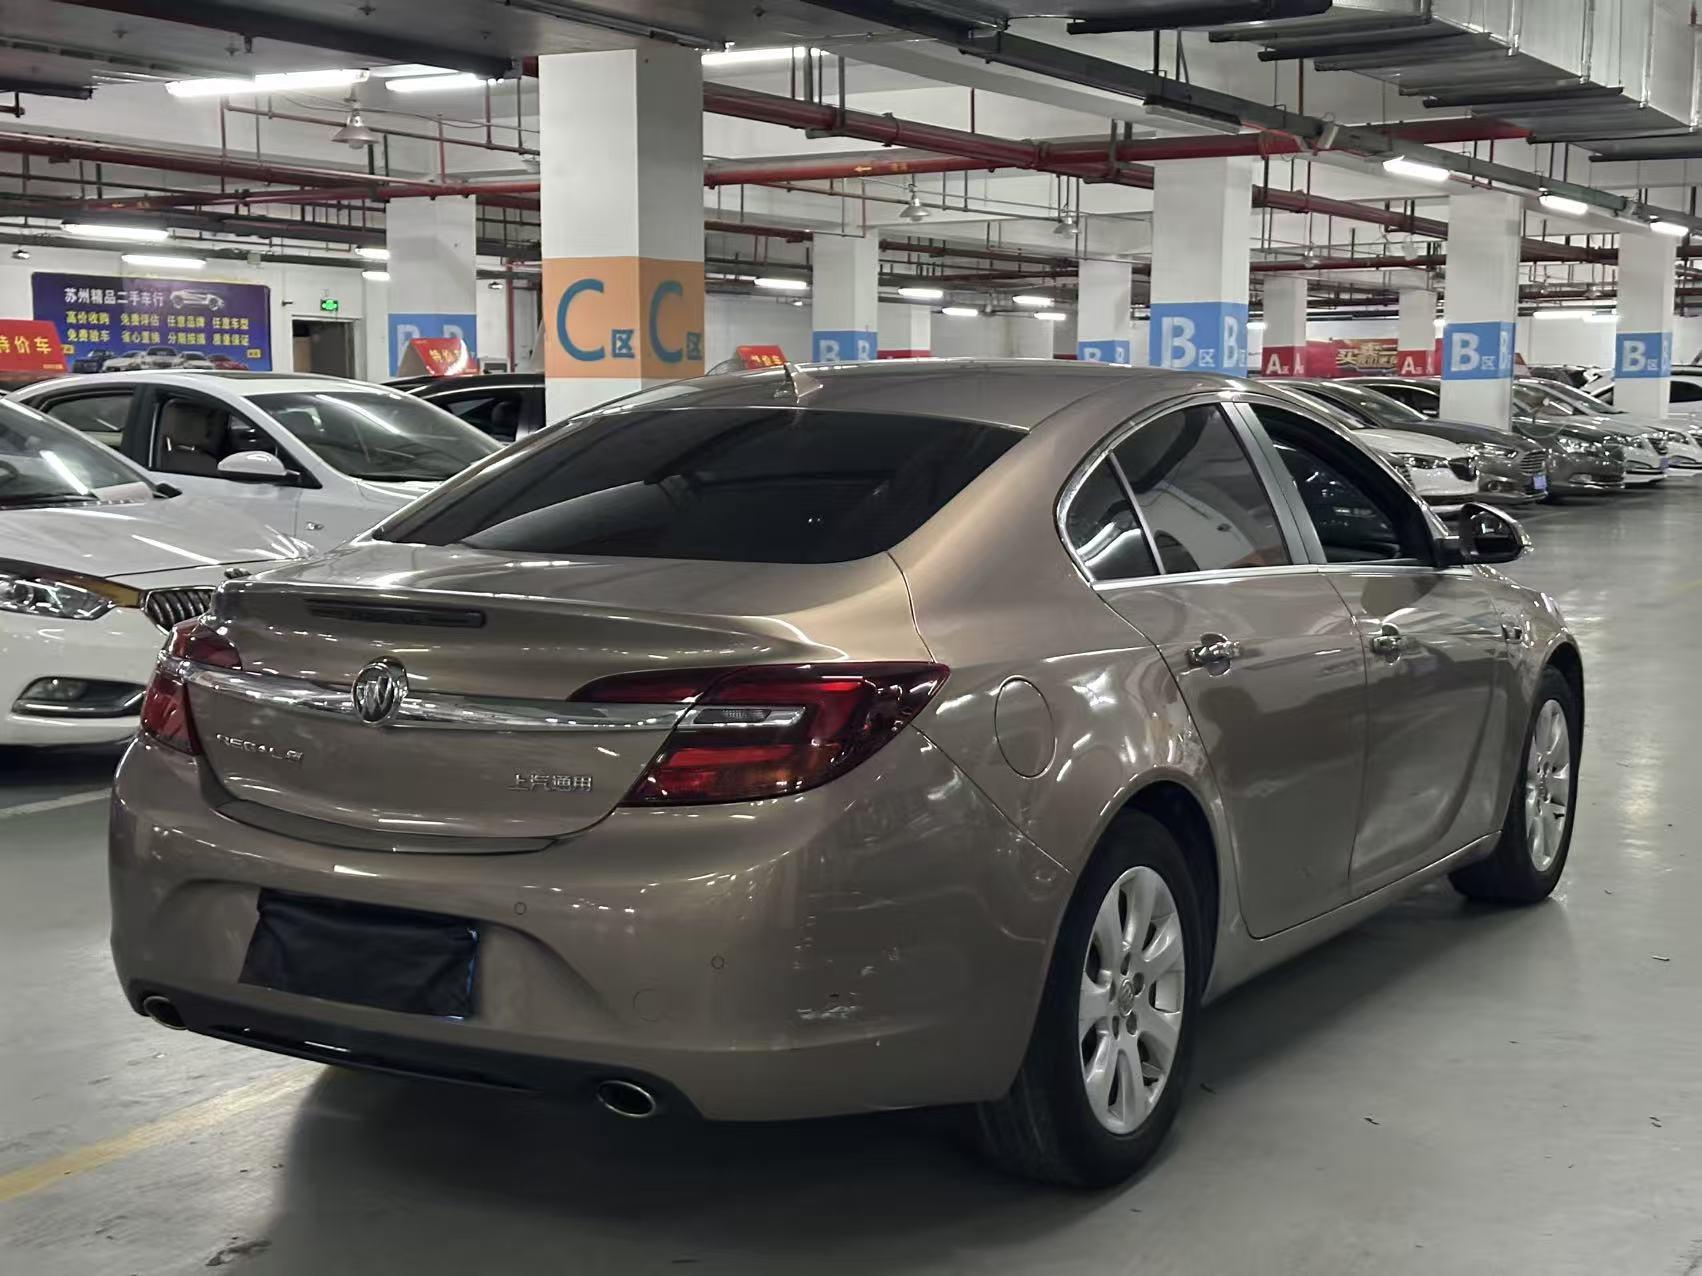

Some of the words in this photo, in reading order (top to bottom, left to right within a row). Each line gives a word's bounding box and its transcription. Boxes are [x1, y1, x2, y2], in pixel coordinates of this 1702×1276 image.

[64, 287, 165, 307] 苏州精品二手车行
[66, 310, 110, 326] 高价收购
[557, 278, 636, 362] C区
[505, 773, 593, 793] 上汽通用
